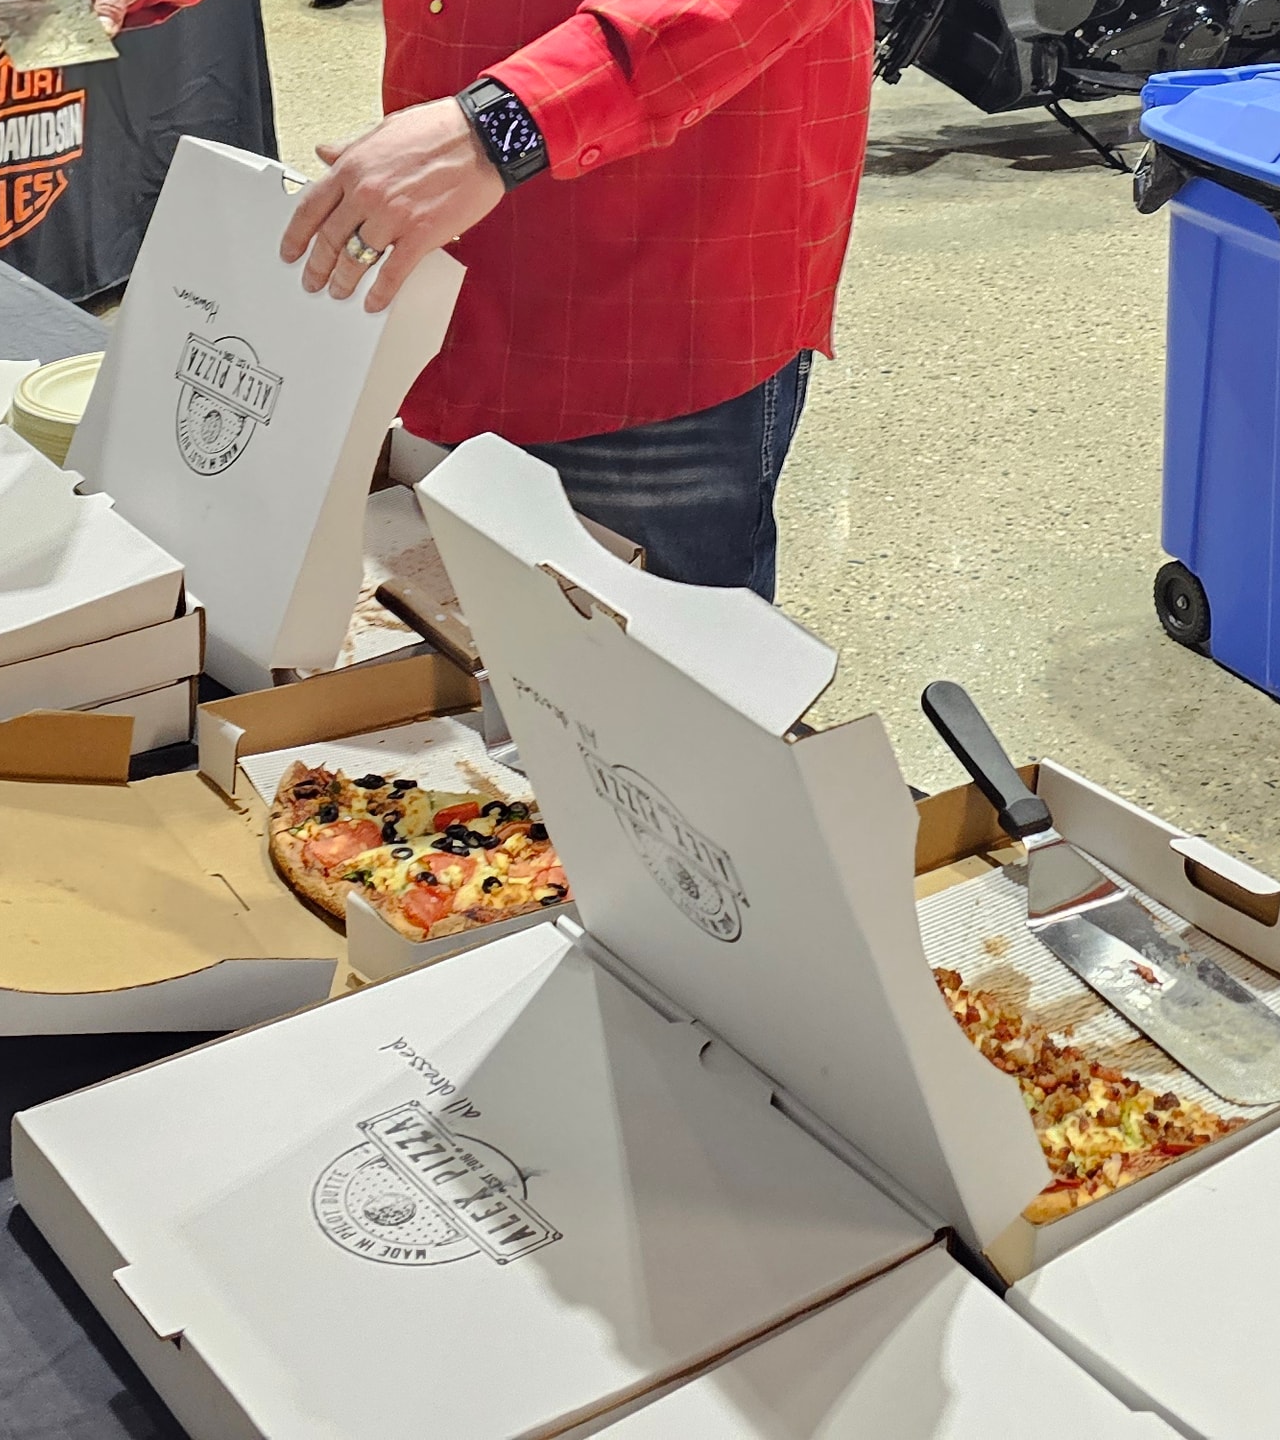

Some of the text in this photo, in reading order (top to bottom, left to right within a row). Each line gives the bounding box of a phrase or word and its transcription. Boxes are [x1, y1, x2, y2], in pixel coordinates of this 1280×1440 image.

[187, 346, 231, 389] PIZZA
[232, 370, 273, 410] ALEX
[378, 1036, 482, 1119] all dressed
[321, 1168, 427, 1260] MADE IN PILOT BUTTE
[384, 1116, 537, 1246] ALEX PIZZA
